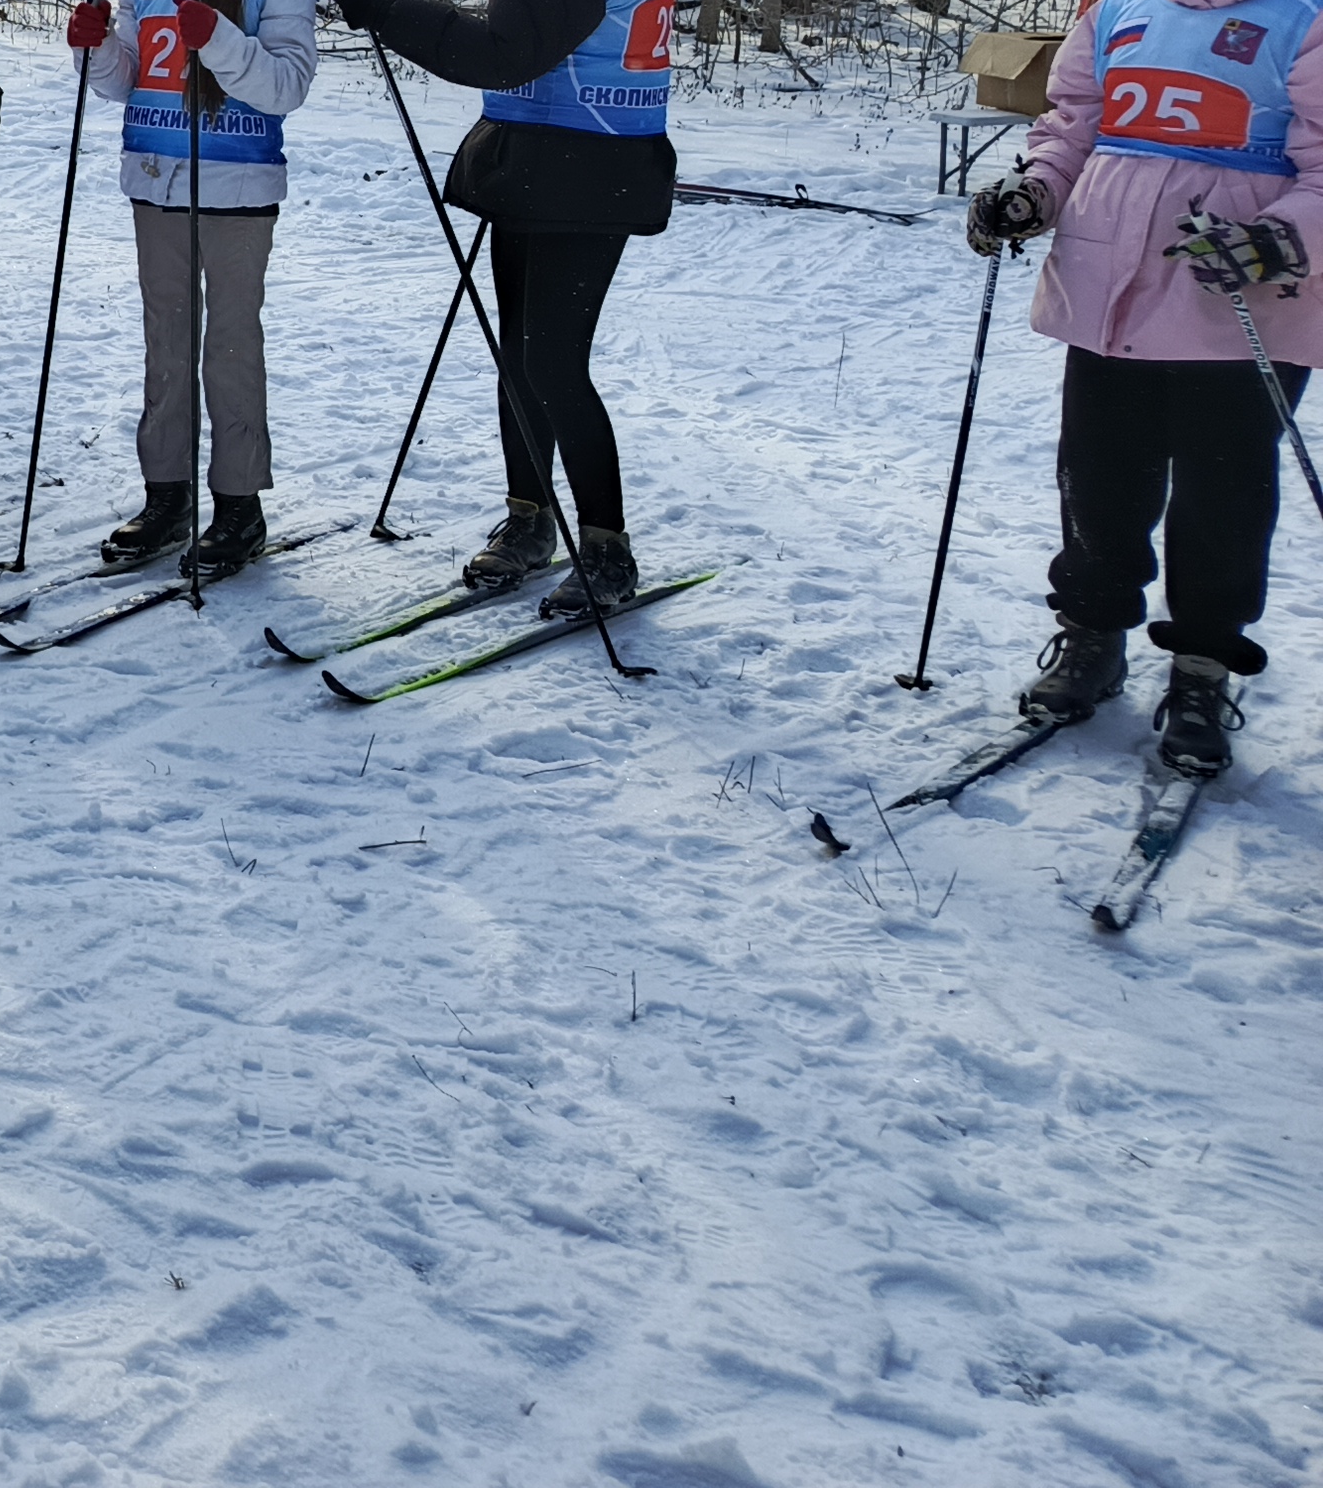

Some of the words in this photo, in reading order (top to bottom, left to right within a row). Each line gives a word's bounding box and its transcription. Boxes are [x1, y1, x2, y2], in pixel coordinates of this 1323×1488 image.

[201, 109, 265, 136] РАЙОН
[1111, 82, 1202, 132] 25
[985, 260, 1000, 310] NORDWAY
[1239, 313, 1270, 370] NORDWAY
